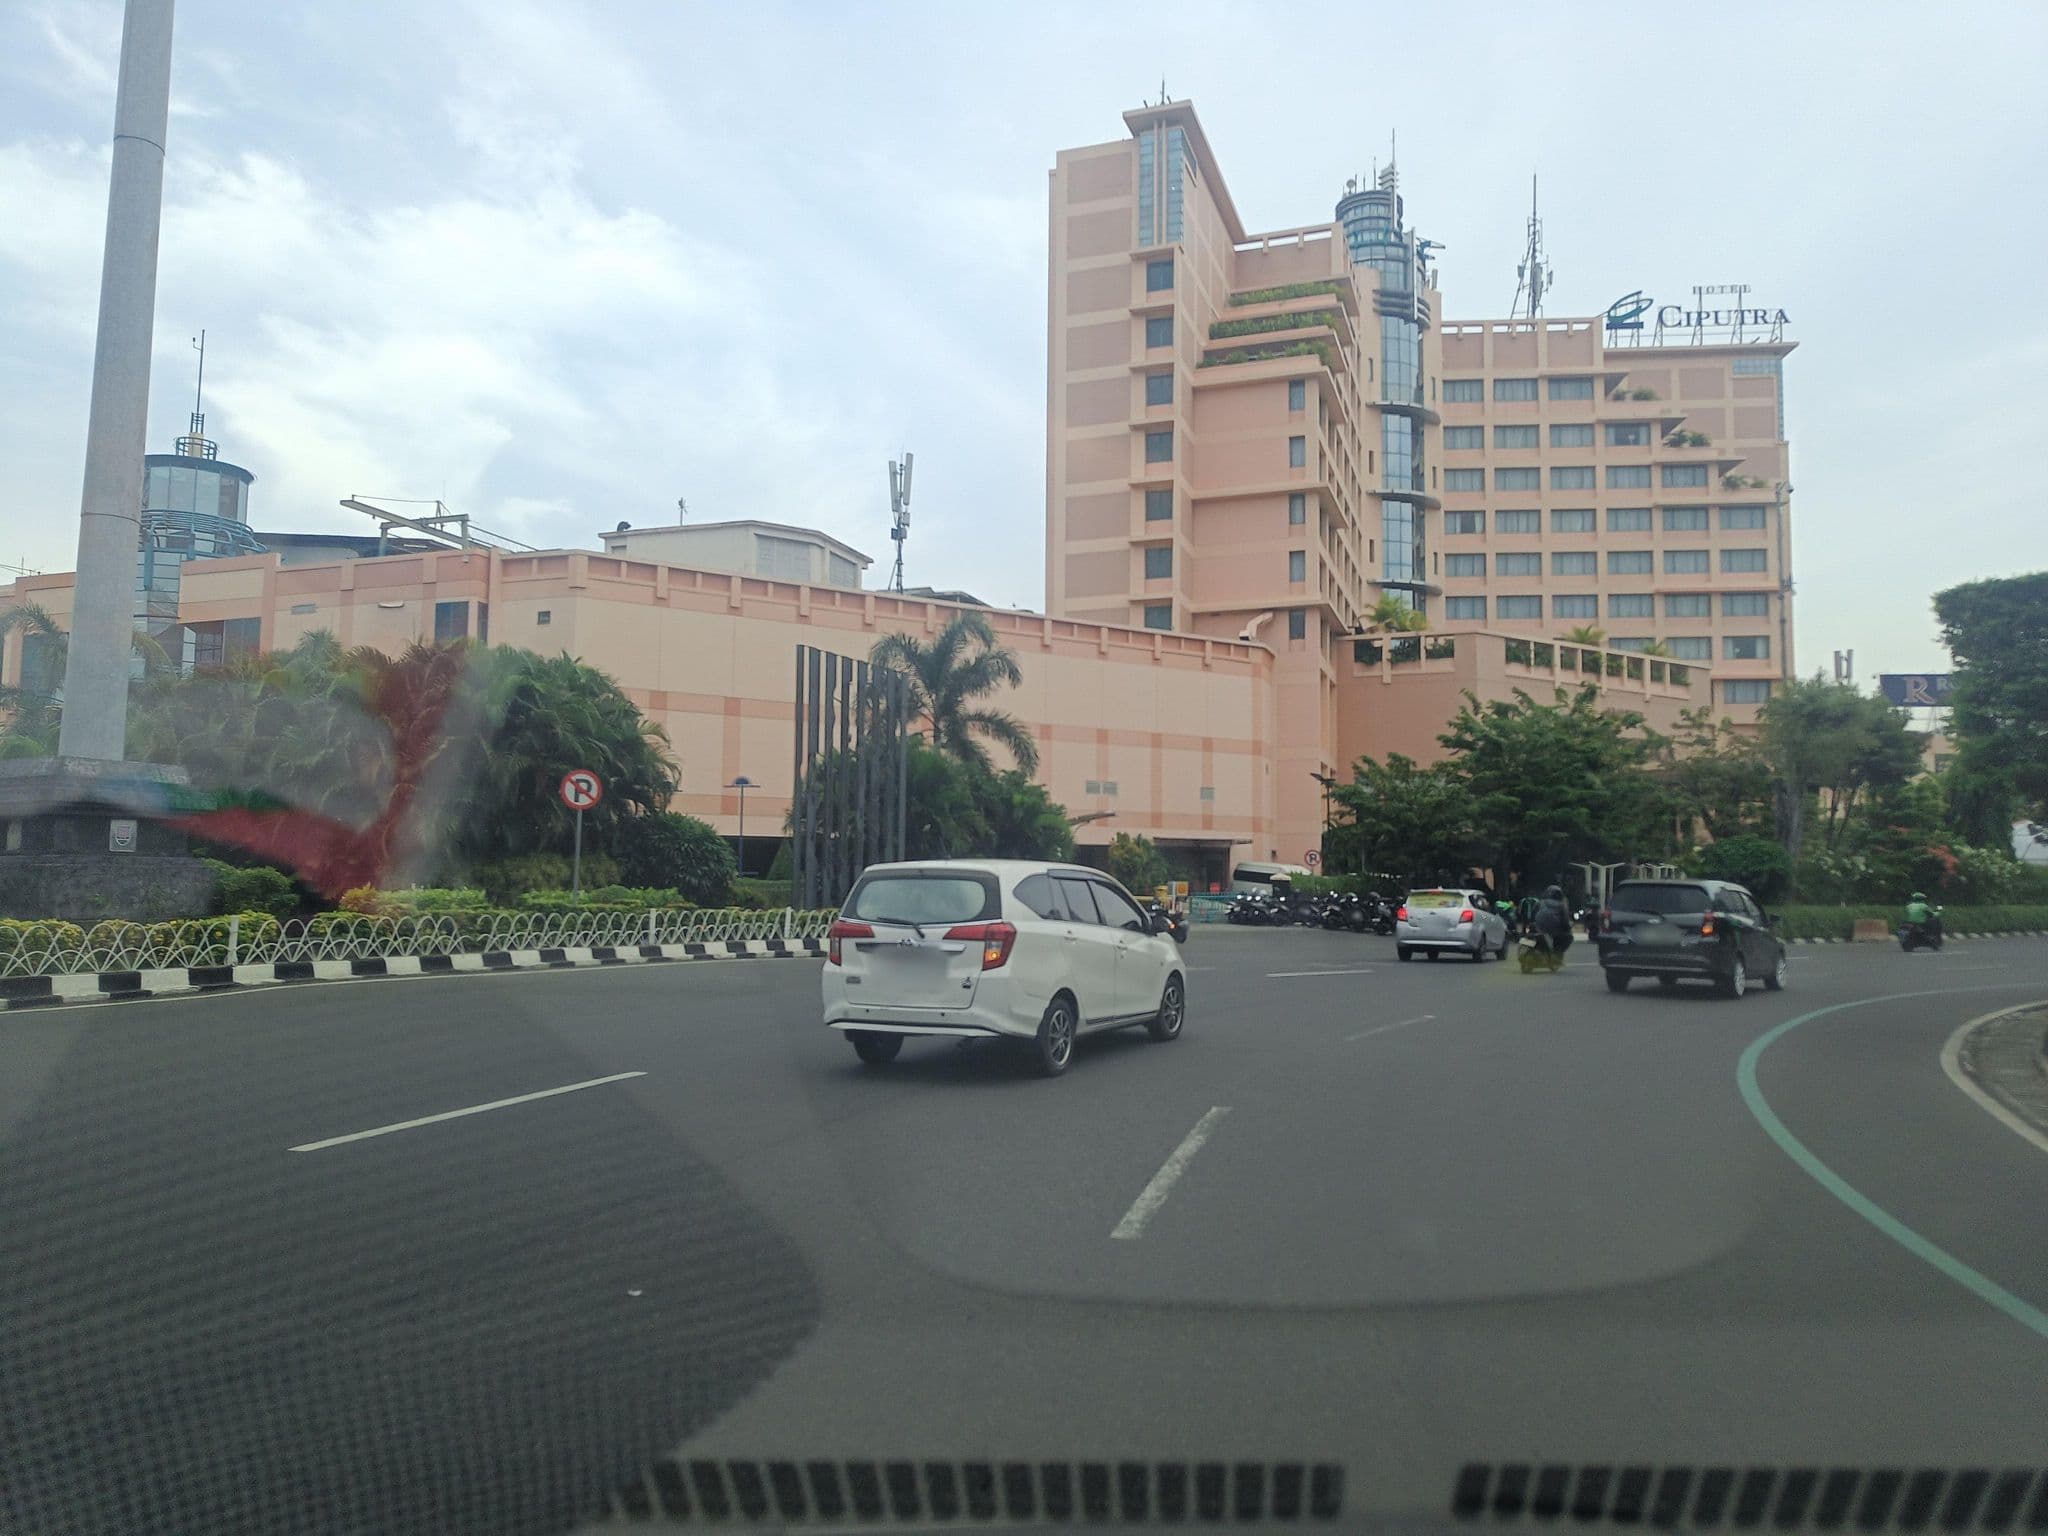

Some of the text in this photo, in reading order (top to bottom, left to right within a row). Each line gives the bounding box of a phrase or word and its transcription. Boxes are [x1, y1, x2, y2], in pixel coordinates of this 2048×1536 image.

[1692, 284, 1752, 295] HOTEL
[1660, 305, 1792, 328] CIPUTRA
[574, 779, 592, 802] P
